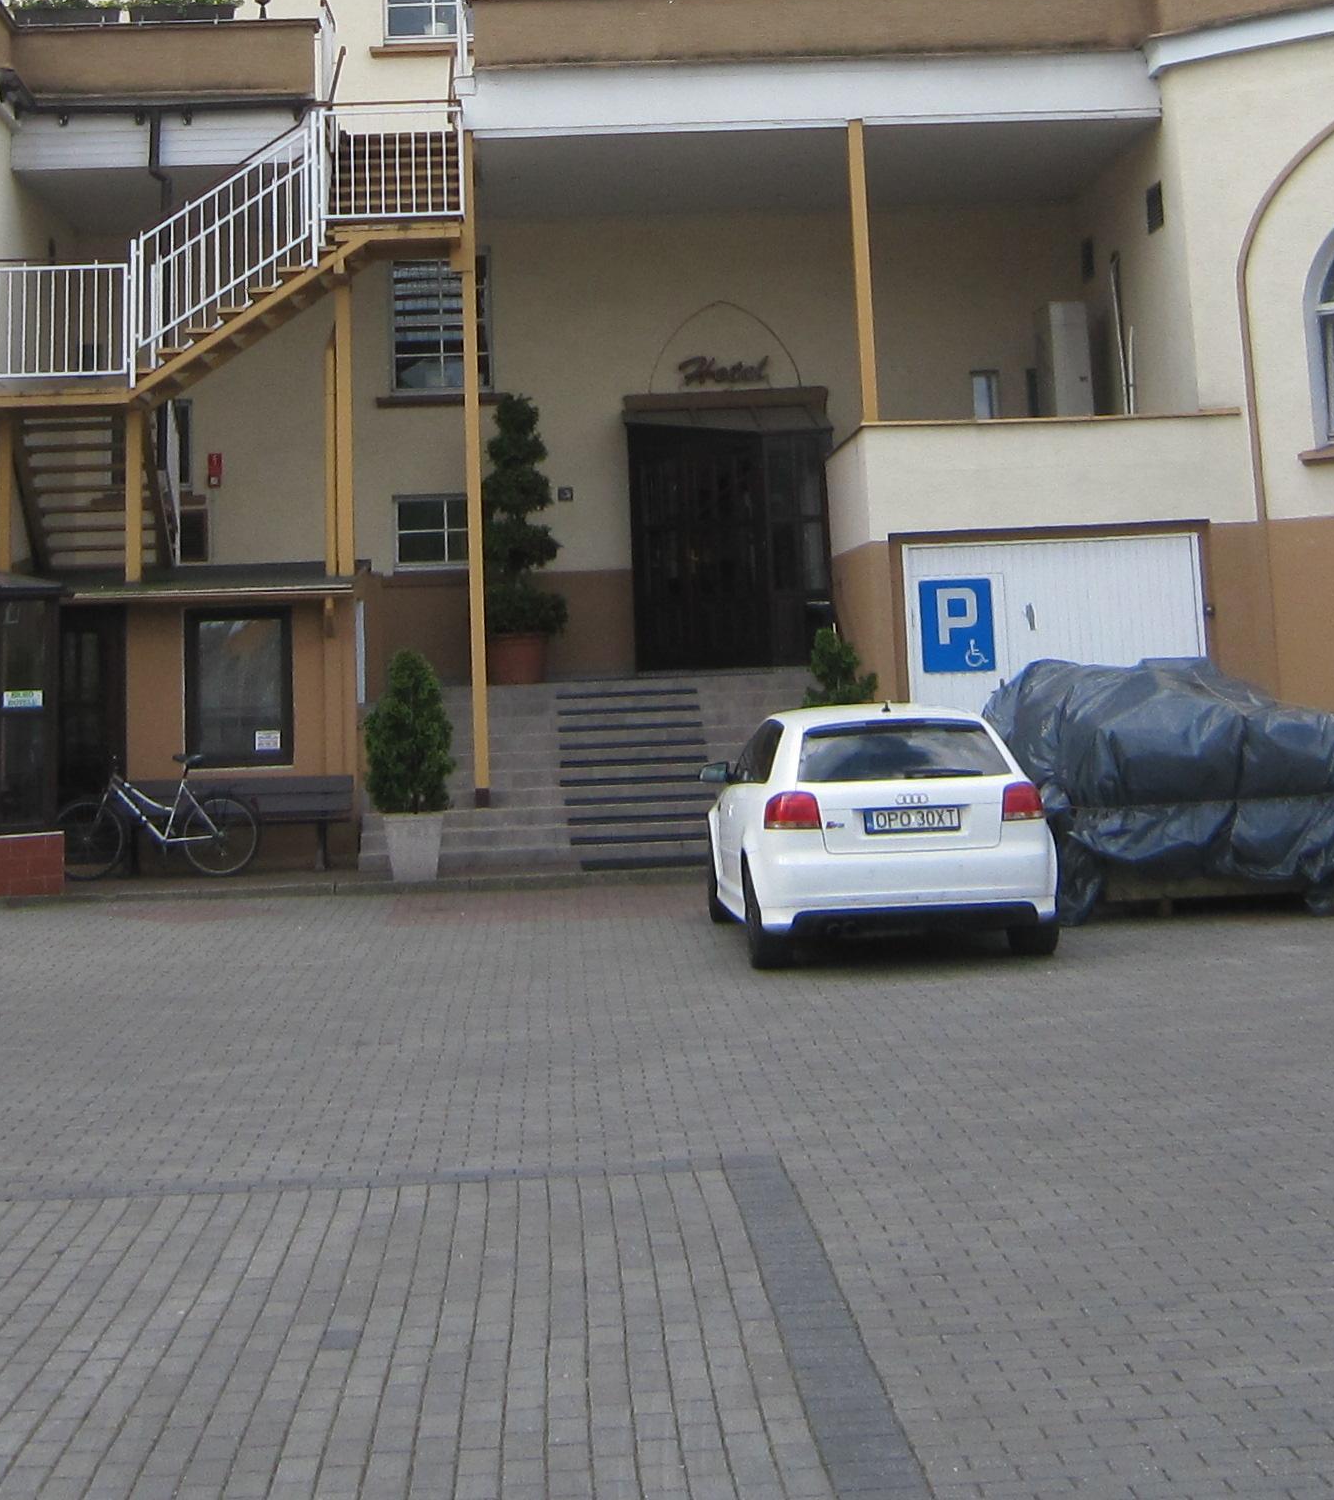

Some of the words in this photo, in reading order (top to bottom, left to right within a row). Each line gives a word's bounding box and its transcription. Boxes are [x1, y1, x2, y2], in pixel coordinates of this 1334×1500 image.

[678, 355, 769, 387] Hotel
[936, 587, 977, 644] P
[875, 811, 912, 829] OPO
